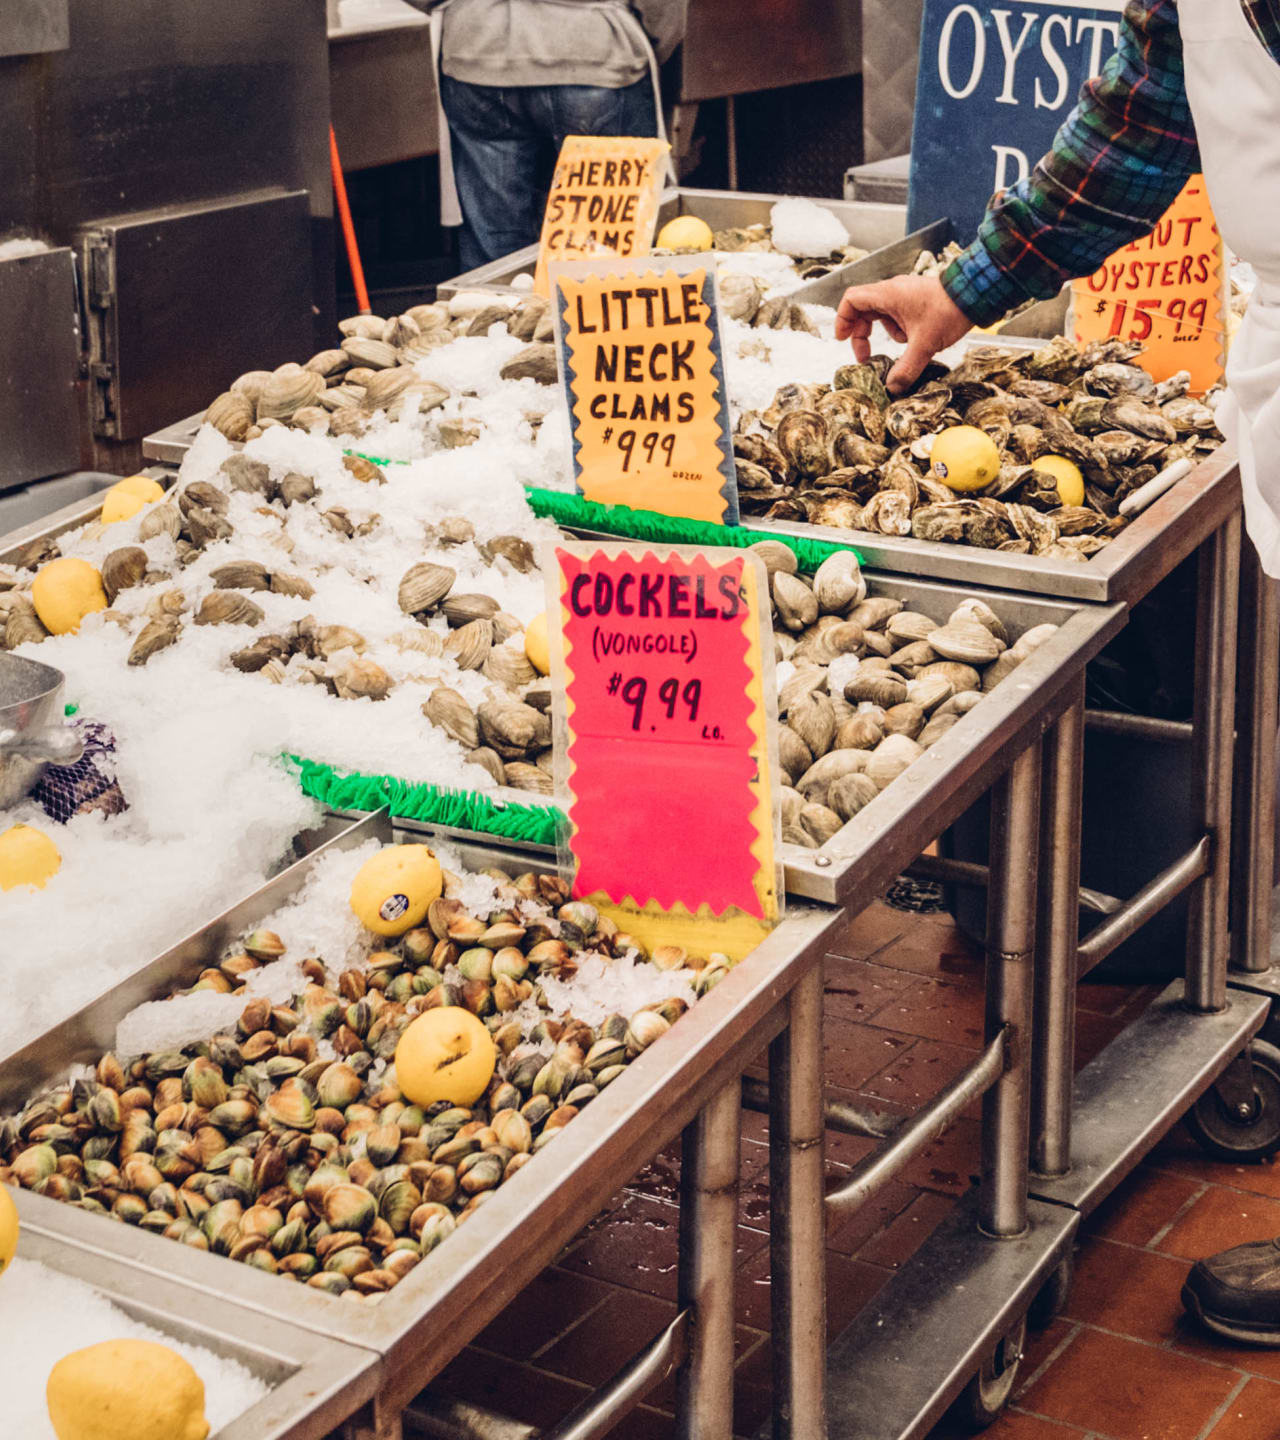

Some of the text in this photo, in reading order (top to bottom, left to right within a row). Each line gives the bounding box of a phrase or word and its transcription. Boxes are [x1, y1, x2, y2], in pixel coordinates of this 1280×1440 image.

[938, 3, 1120, 111] OYST
[547, 195, 640, 223] STONE
[548, 229, 635, 255] CLAMS
[1087, 254, 1210, 292] OYSTERS
[1093, 298, 1207, 343] $15.99
[595, 339, 695, 383] NECK
[590, 392, 695, 423] CLAMS
[672, 470, 703, 481] DOZEN
[571, 572, 740, 620] COCKELS
[593, 626, 698, 664] (VONGOLE)
